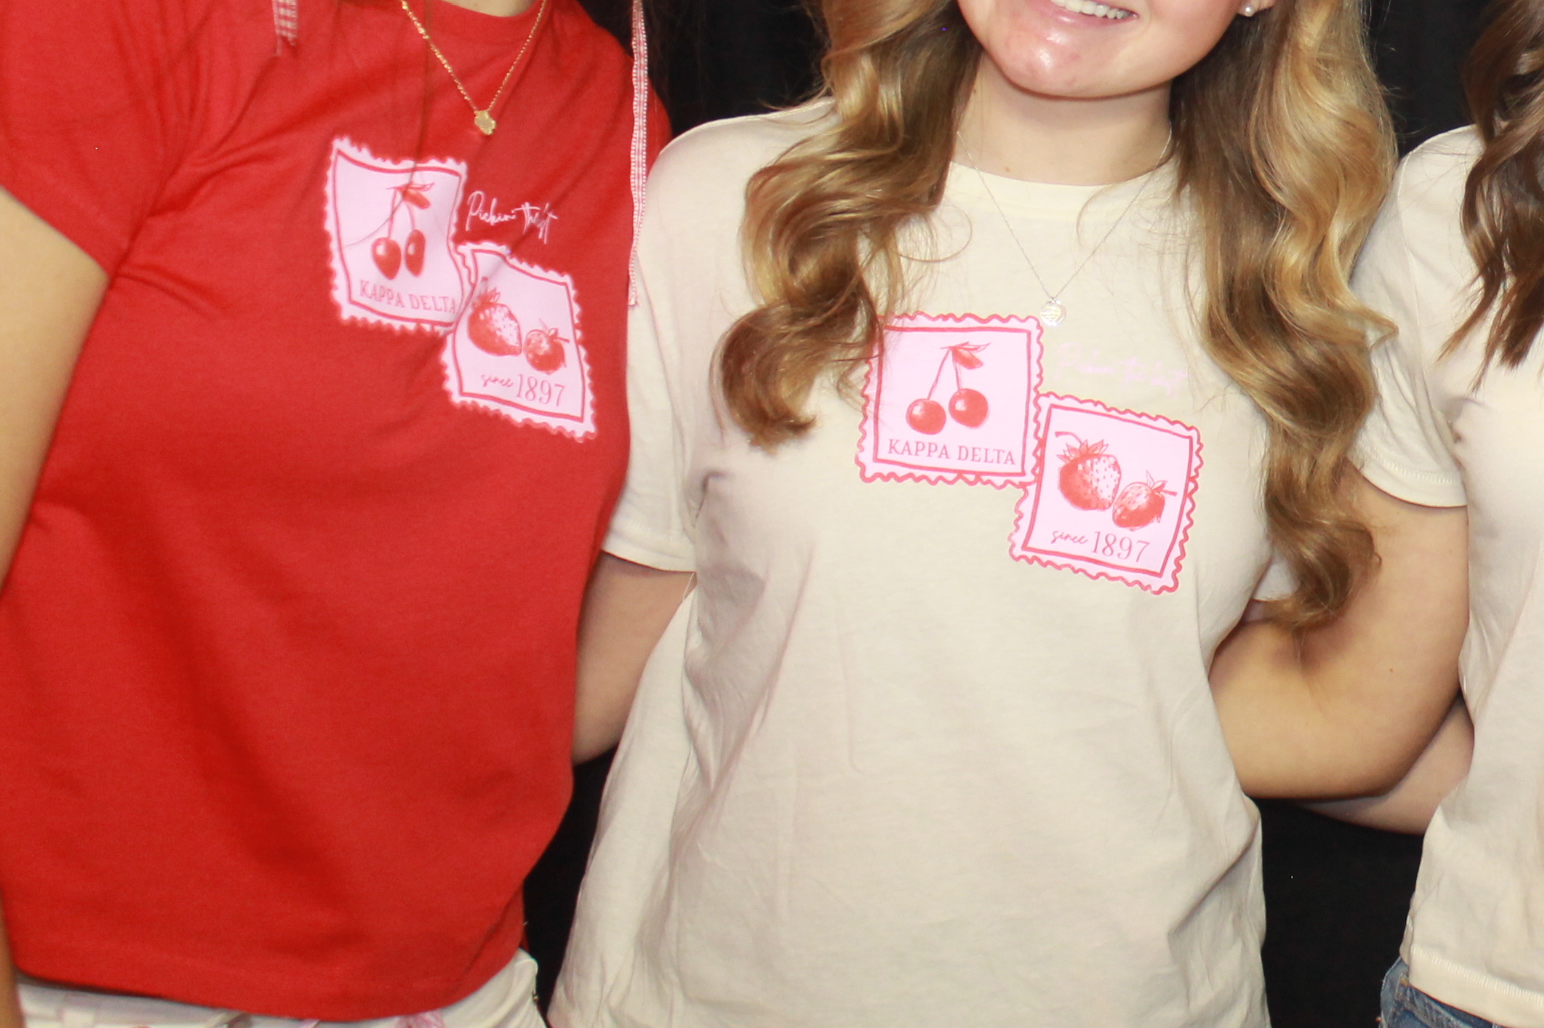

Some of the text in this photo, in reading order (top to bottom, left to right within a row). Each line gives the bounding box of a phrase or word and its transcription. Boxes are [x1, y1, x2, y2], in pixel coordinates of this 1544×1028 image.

[360, 280, 458, 313] KAPPA DELTA
[516, 374, 565, 407] 1897
[888, 439, 1016, 465] KAPPA DELTA
[1051, 531, 1150, 563] since 1897
